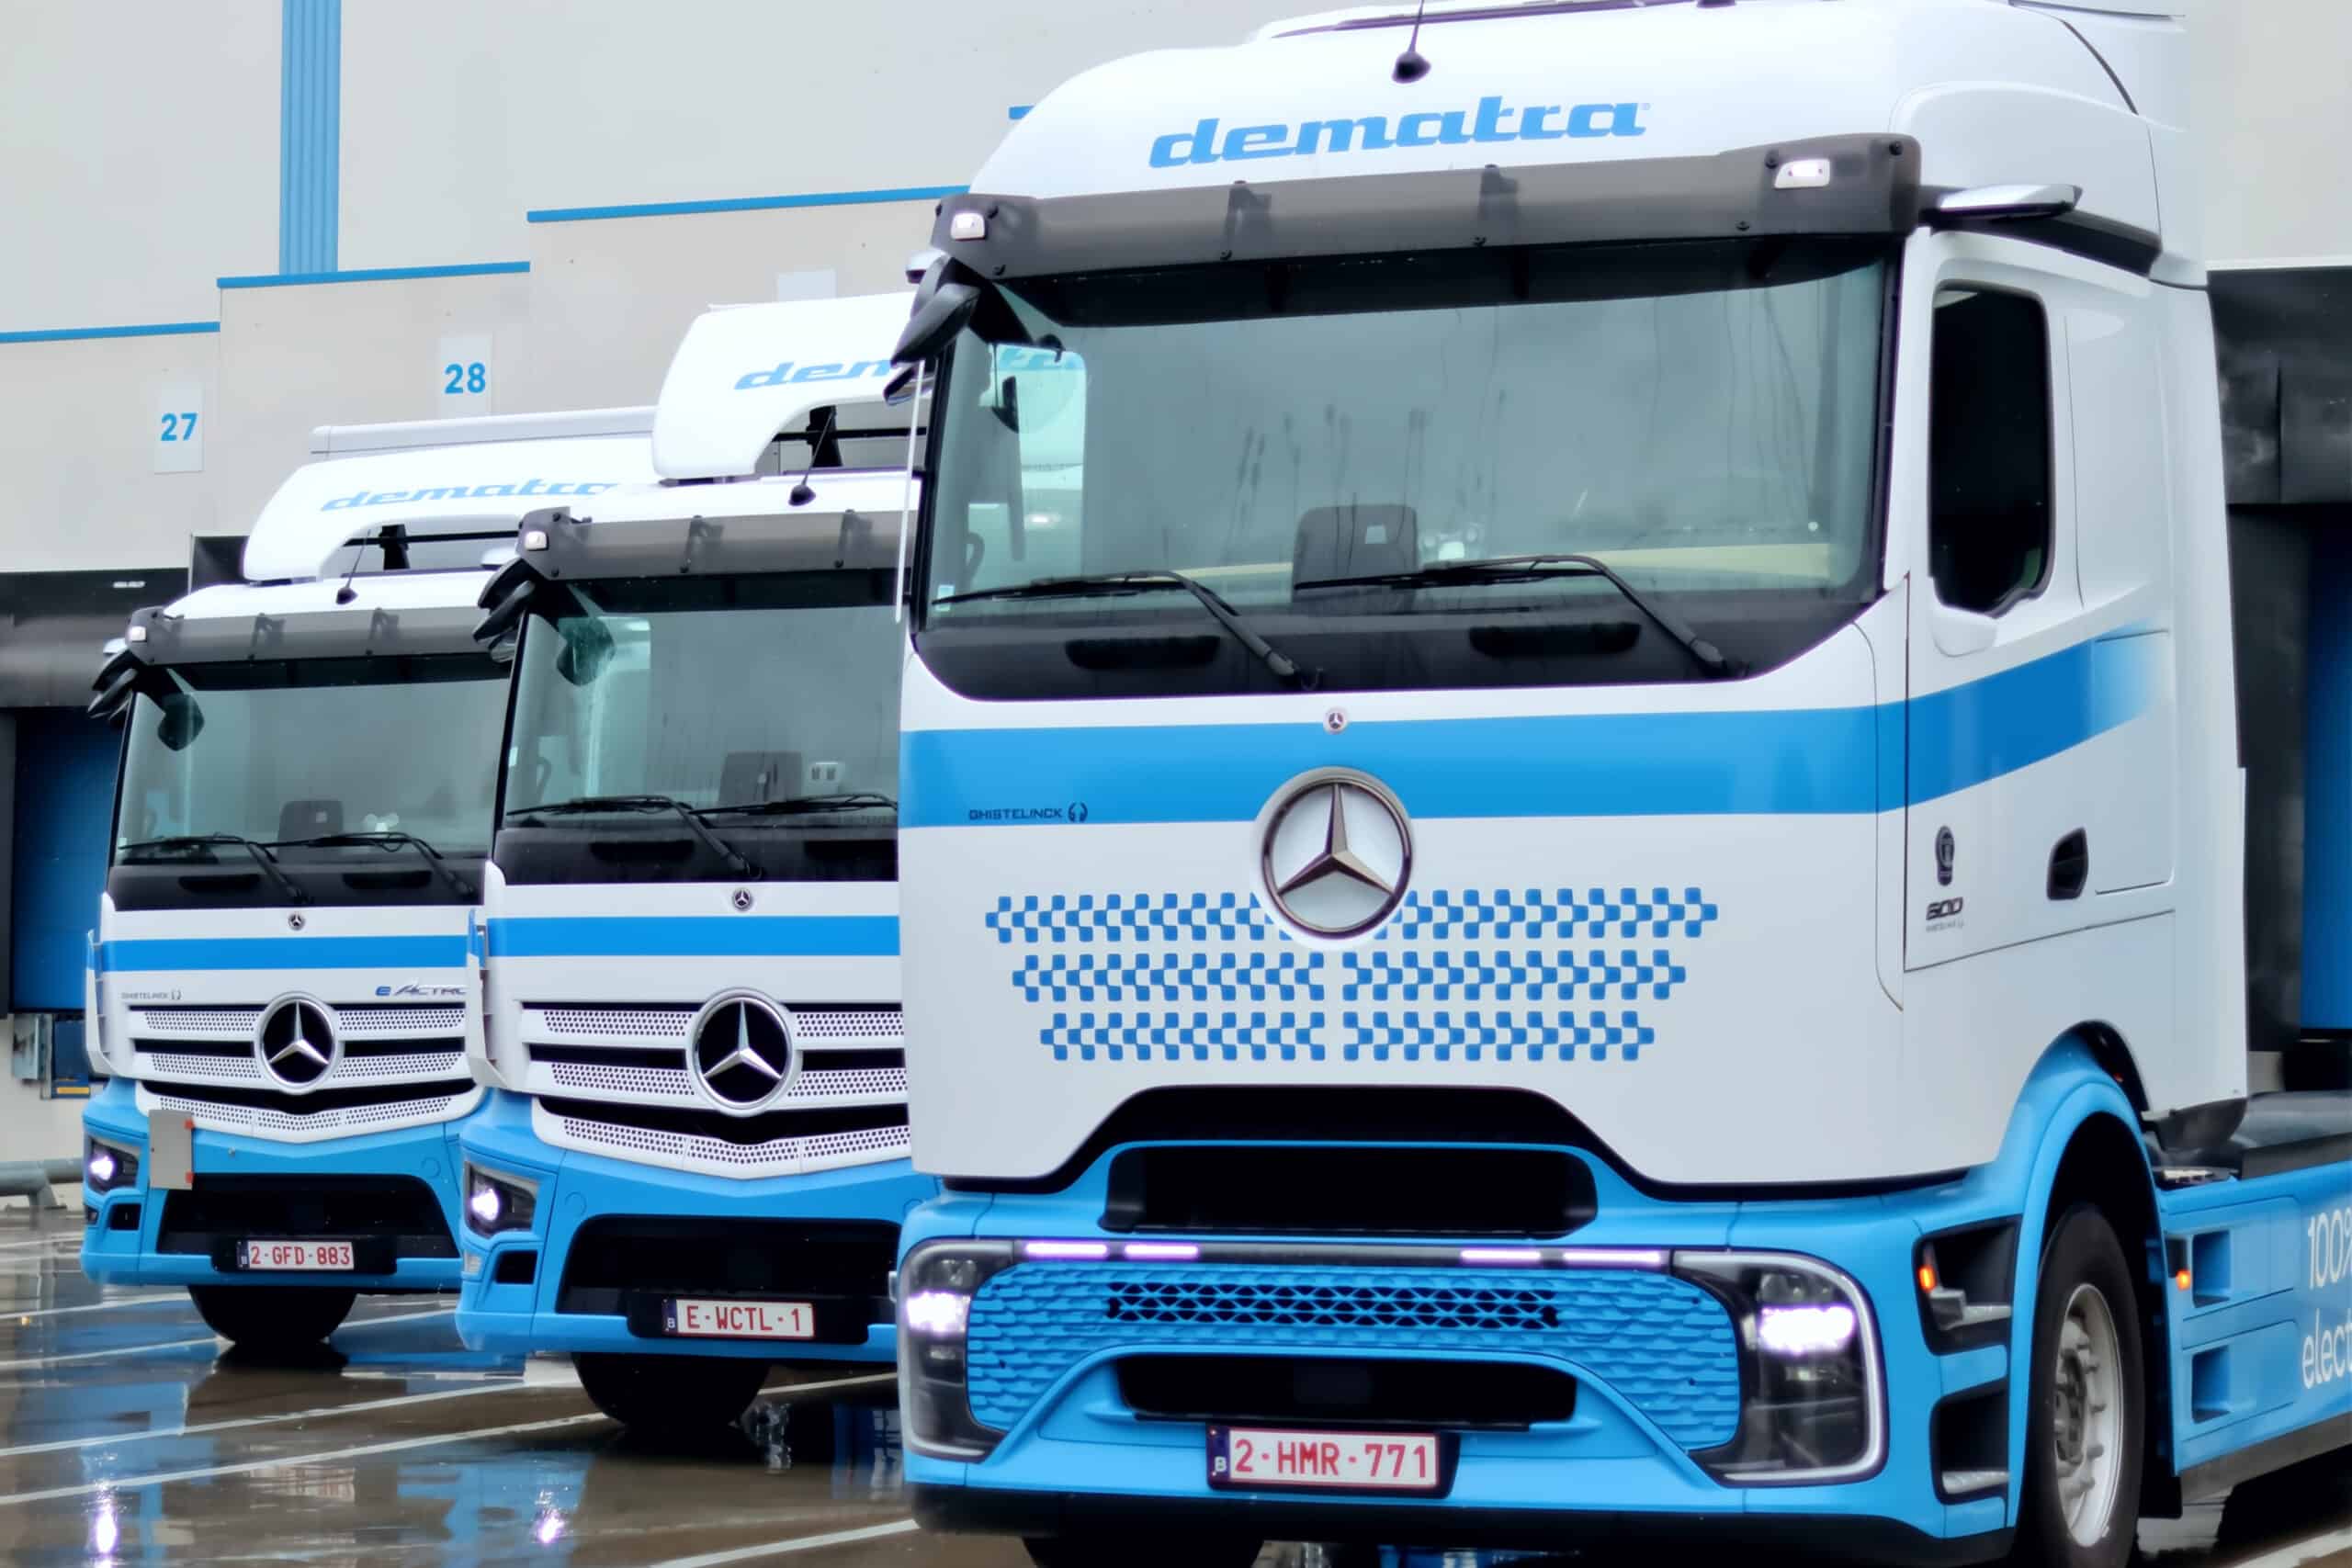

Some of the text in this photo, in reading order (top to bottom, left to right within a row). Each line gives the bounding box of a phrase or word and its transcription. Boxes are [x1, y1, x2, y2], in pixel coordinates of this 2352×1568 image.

[1148, 95, 1647, 168] dematra
[444, 362, 487, 395] 28
[160, 412, 198, 442] 27
[250, 1246, 350, 1265] 2-GFD-883
[685, 1304, 801, 1333] E-WCTL-1
[1234, 1438, 1428, 1478] 2-HMR-771
